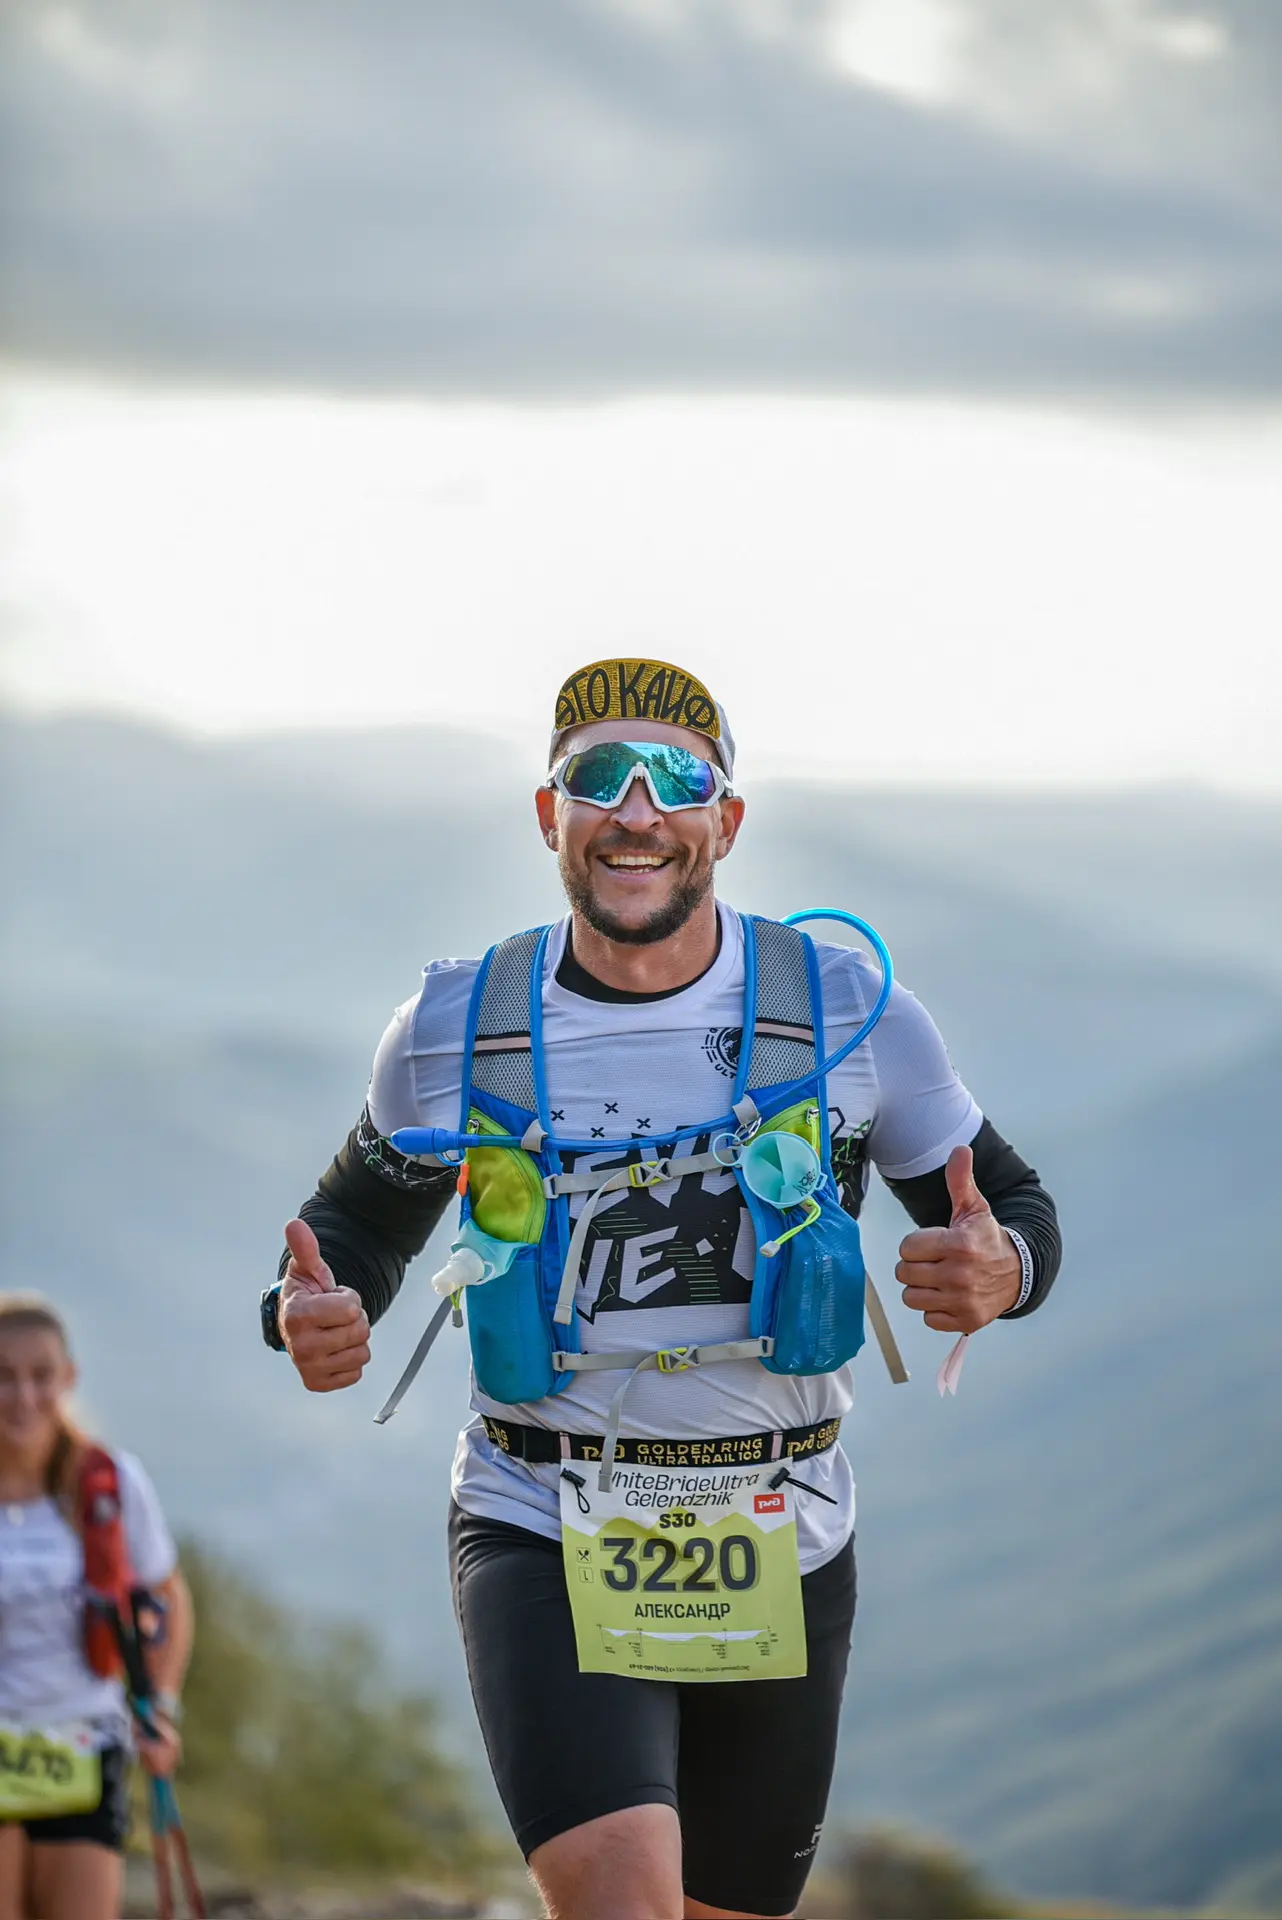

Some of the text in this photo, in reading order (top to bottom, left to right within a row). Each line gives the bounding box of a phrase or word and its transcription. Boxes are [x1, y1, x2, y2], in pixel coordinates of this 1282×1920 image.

[556, 663, 715, 729] ЭТО КАЙФ
[637, 1437, 763, 1456] GOLDEN RING
[637, 1449, 762, 1466] ULTRA TRAIL 100
[599, 1469, 759, 1492] hiteBrideUltra
[624, 1489, 735, 1508] Gelendzhik
[659, 1512, 697, 1529] S30
[601, 1535, 760, 1593] 3220
[634, 1602, 731, 1620] АЛЕКСАНДР
